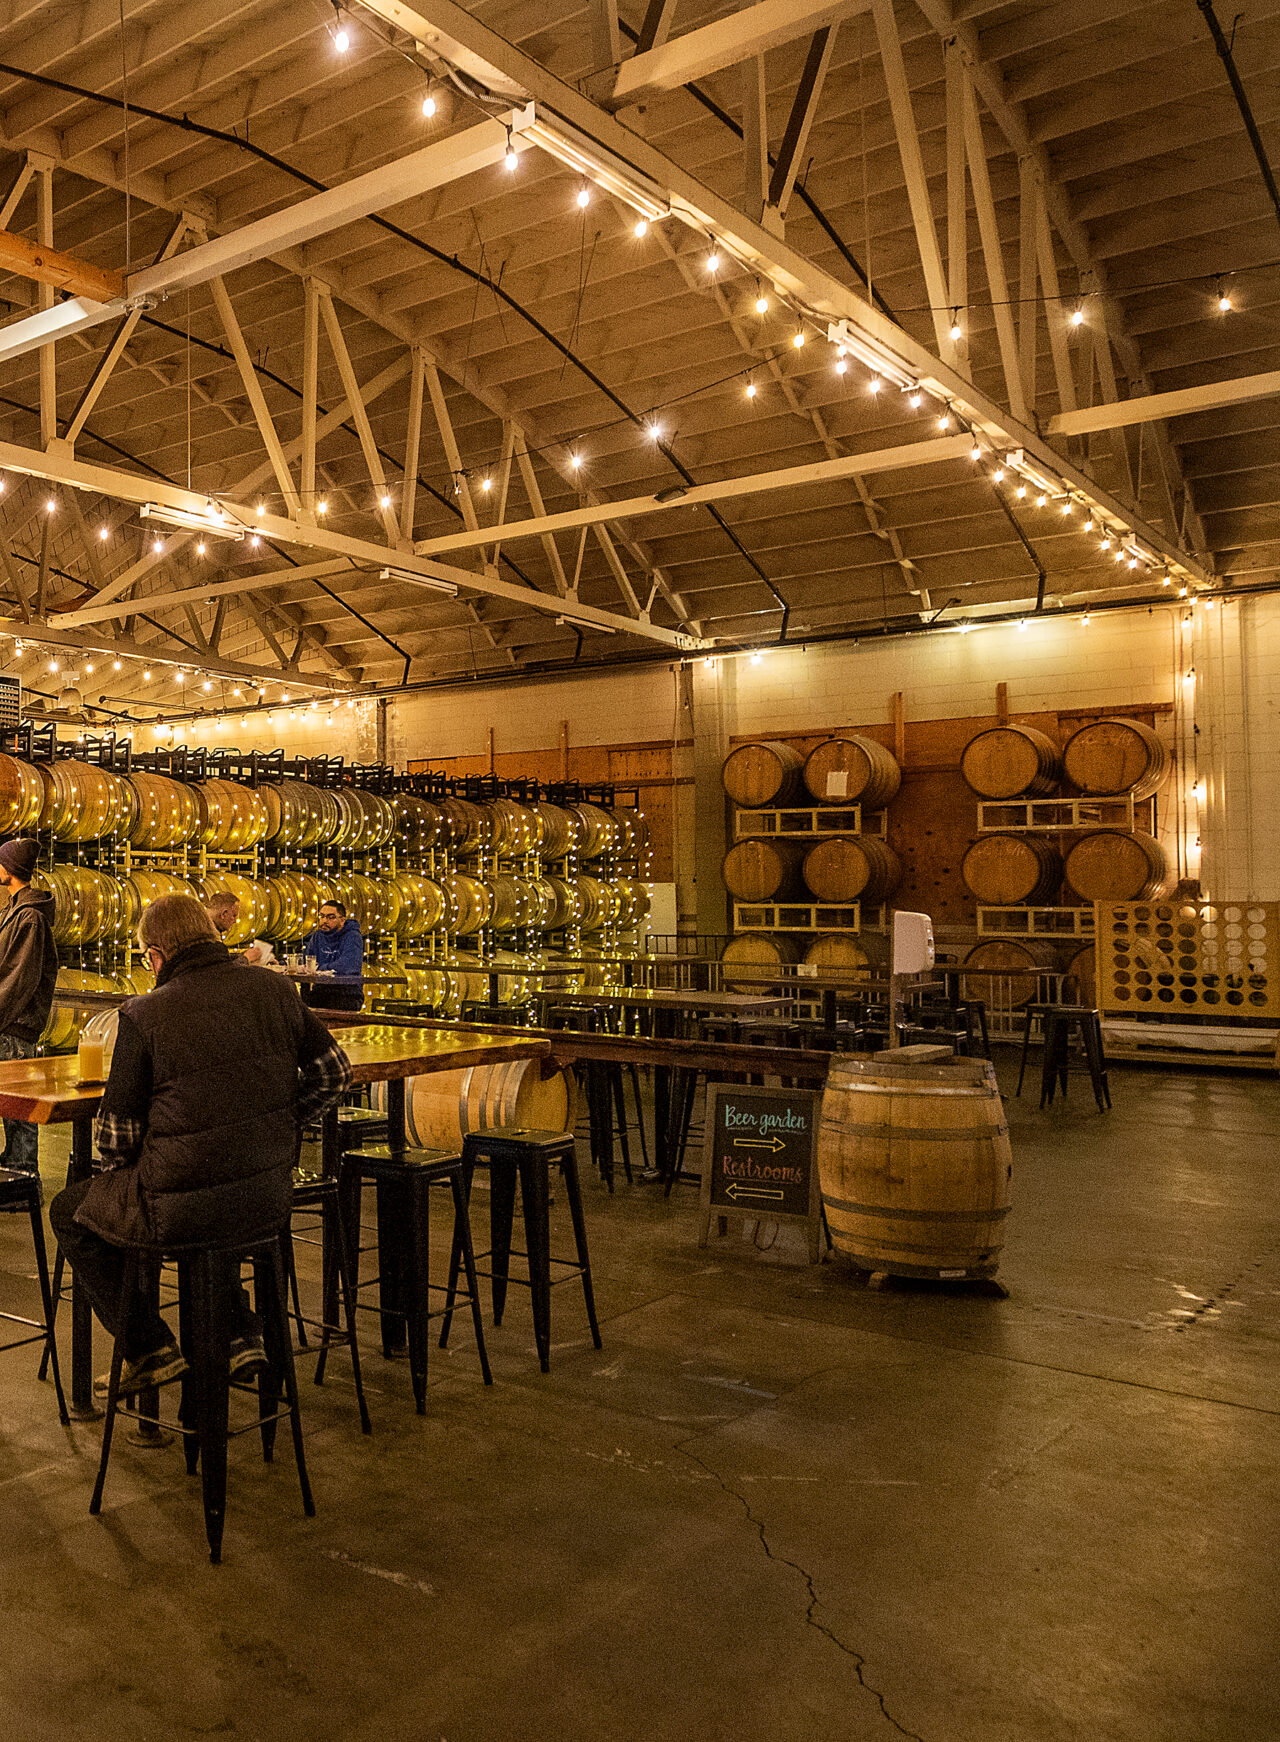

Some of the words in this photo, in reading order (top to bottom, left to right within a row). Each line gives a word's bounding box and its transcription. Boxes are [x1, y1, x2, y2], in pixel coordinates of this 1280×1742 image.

[725, 1104, 758, 1127] Beer
[758, 1108, 807, 1136] garden
[723, 1155, 804, 1183] Restrooms
